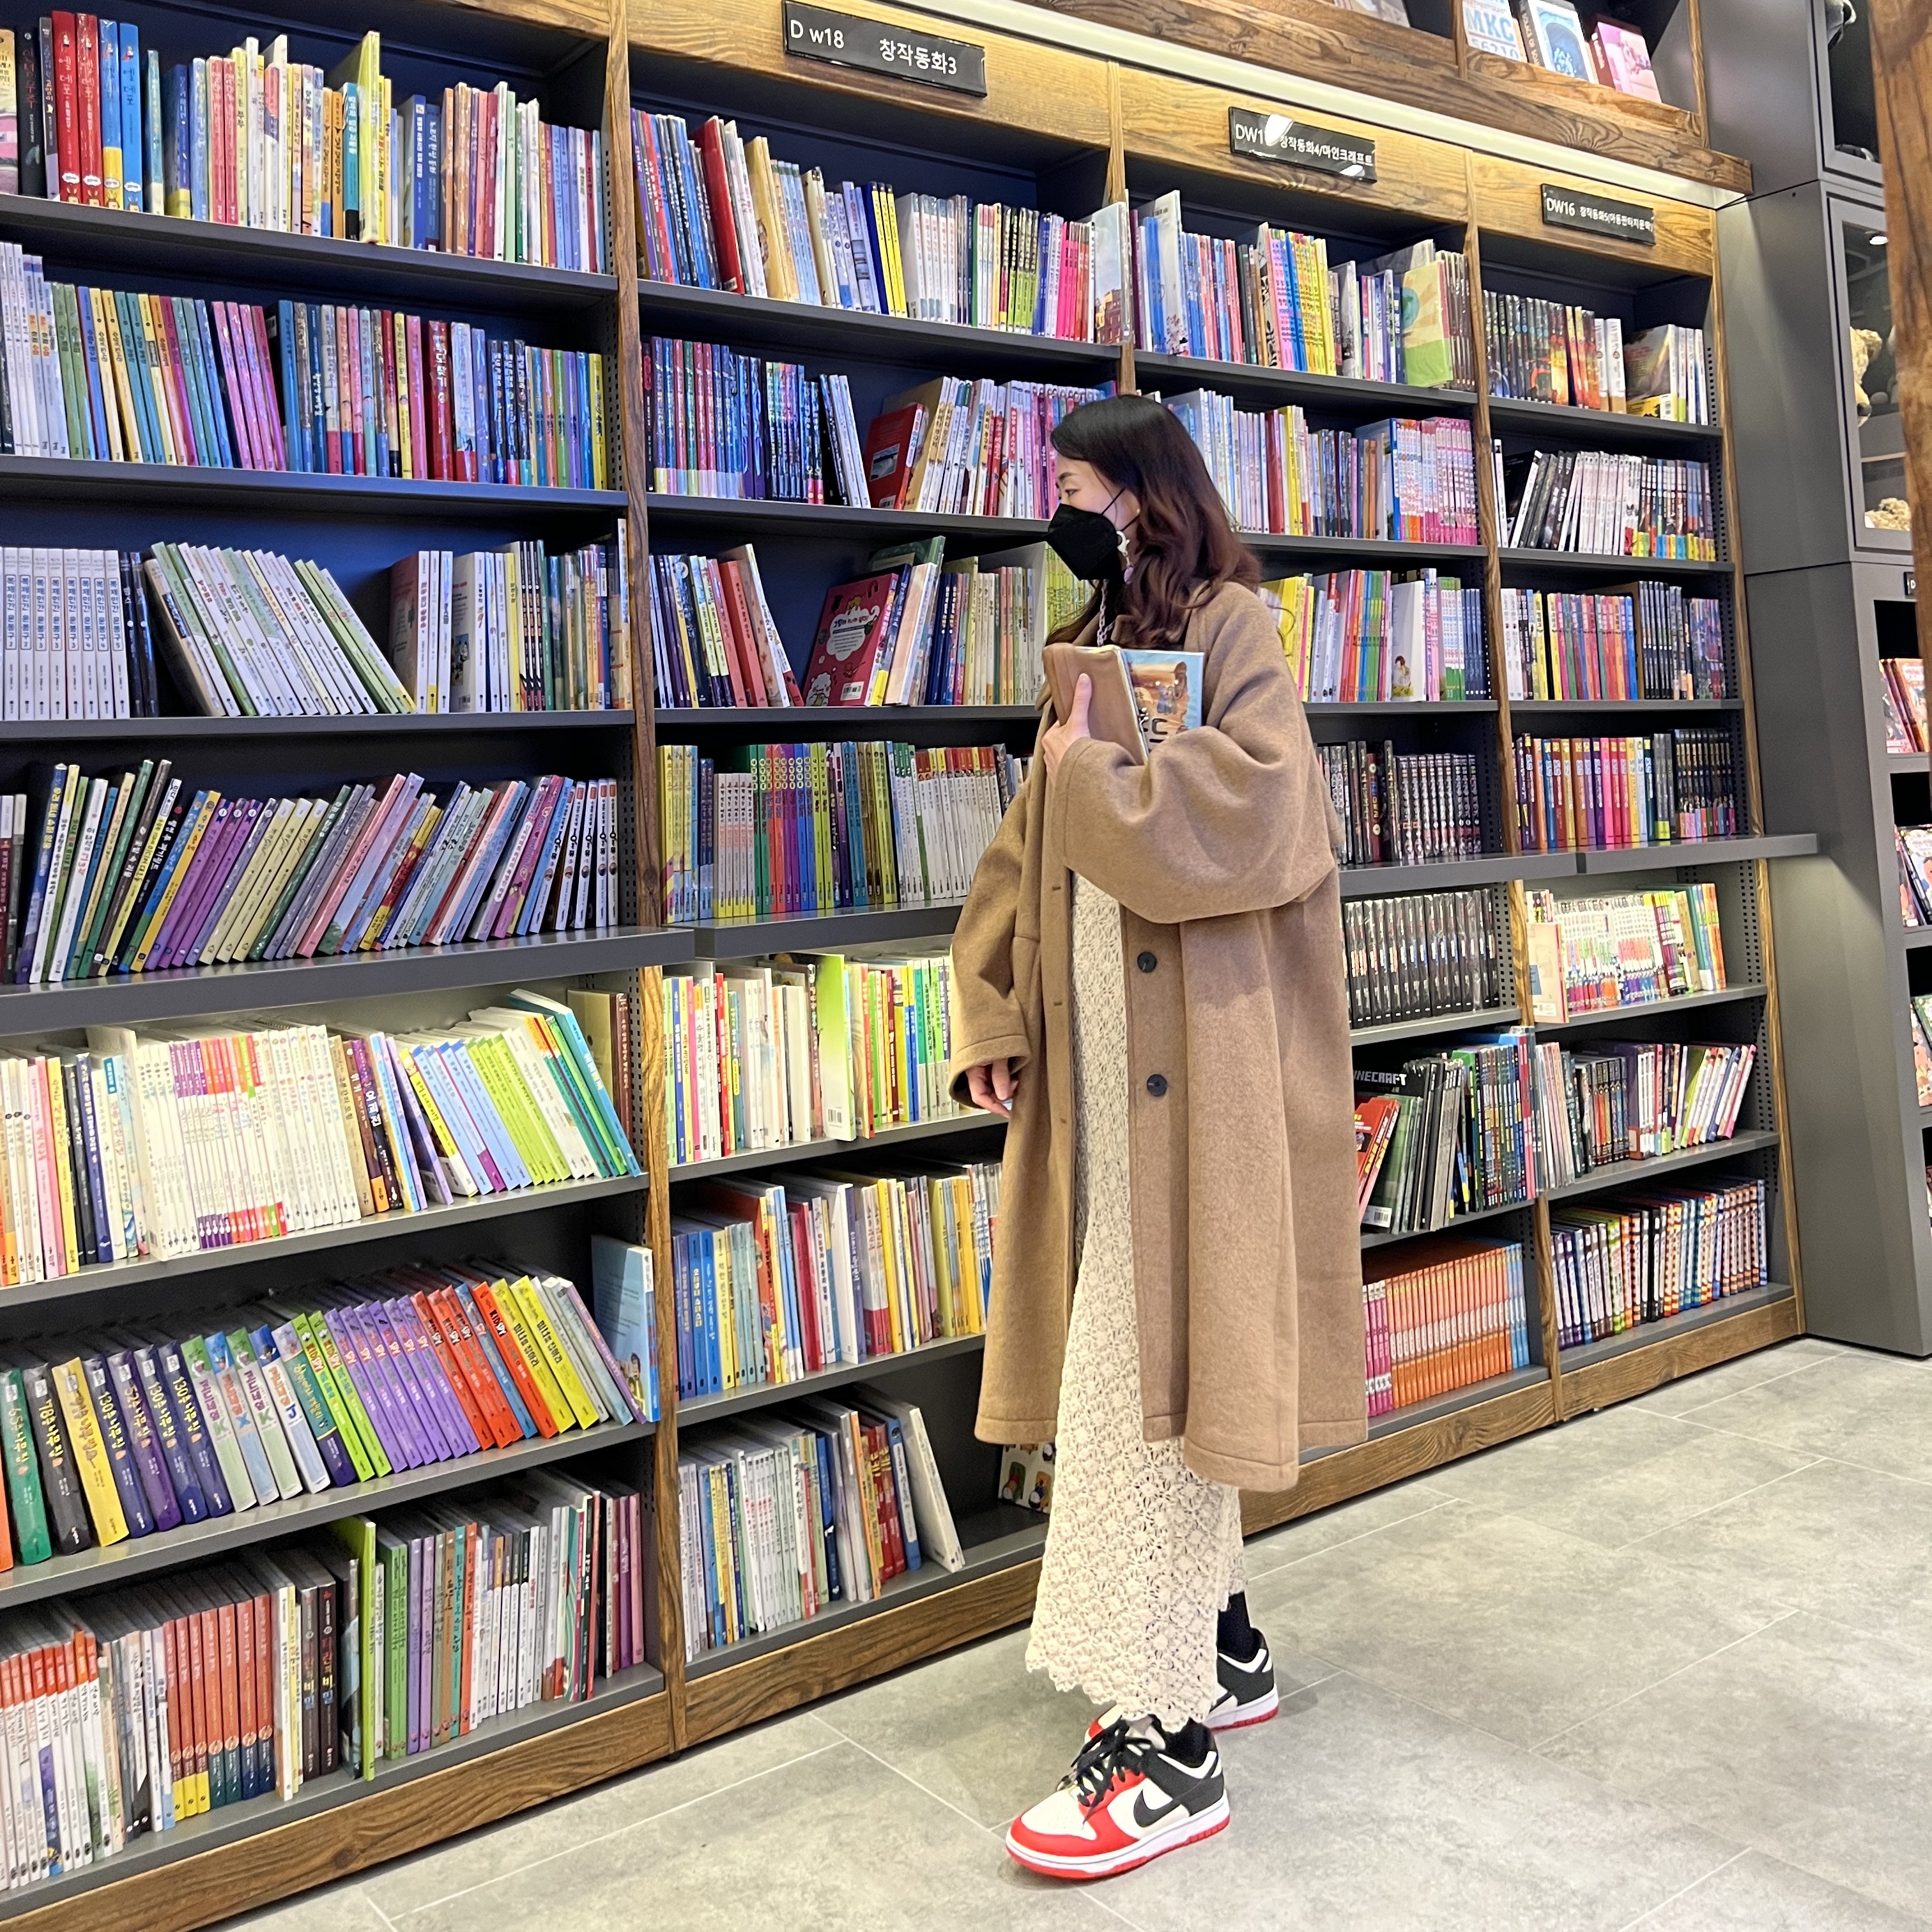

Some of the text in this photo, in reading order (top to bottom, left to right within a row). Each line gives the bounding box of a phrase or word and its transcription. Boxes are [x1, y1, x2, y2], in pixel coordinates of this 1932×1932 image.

[790, 19, 804, 38] D
[1466, 8, 1514, 42] MKC
[879, 38, 957, 75] 창작동화3
[1236, 123, 1265, 144] DW1
[1546, 197, 1575, 217] DW16
[6, 578, 15, 612] 복제인간
[22, 578, 30, 612] 복제인간
[36, 579, 45, 613] 복제인간
[52, 579, 61, 613] 복제인간
[68, 579, 77, 613] 복제인간
[82, 580, 91, 613] 복제인간
[97, 581, 106, 613] 복제인간
[110, 581, 119, 613] 복제인간
[22, 615, 31, 639] 윤봉구
[84, 617, 92, 640] 윤봉구
[98, 617, 107, 641] 윤봉구
[112, 617, 121, 641] 윤봉구
[1353, 1071, 1406, 1086] INECRAFT
